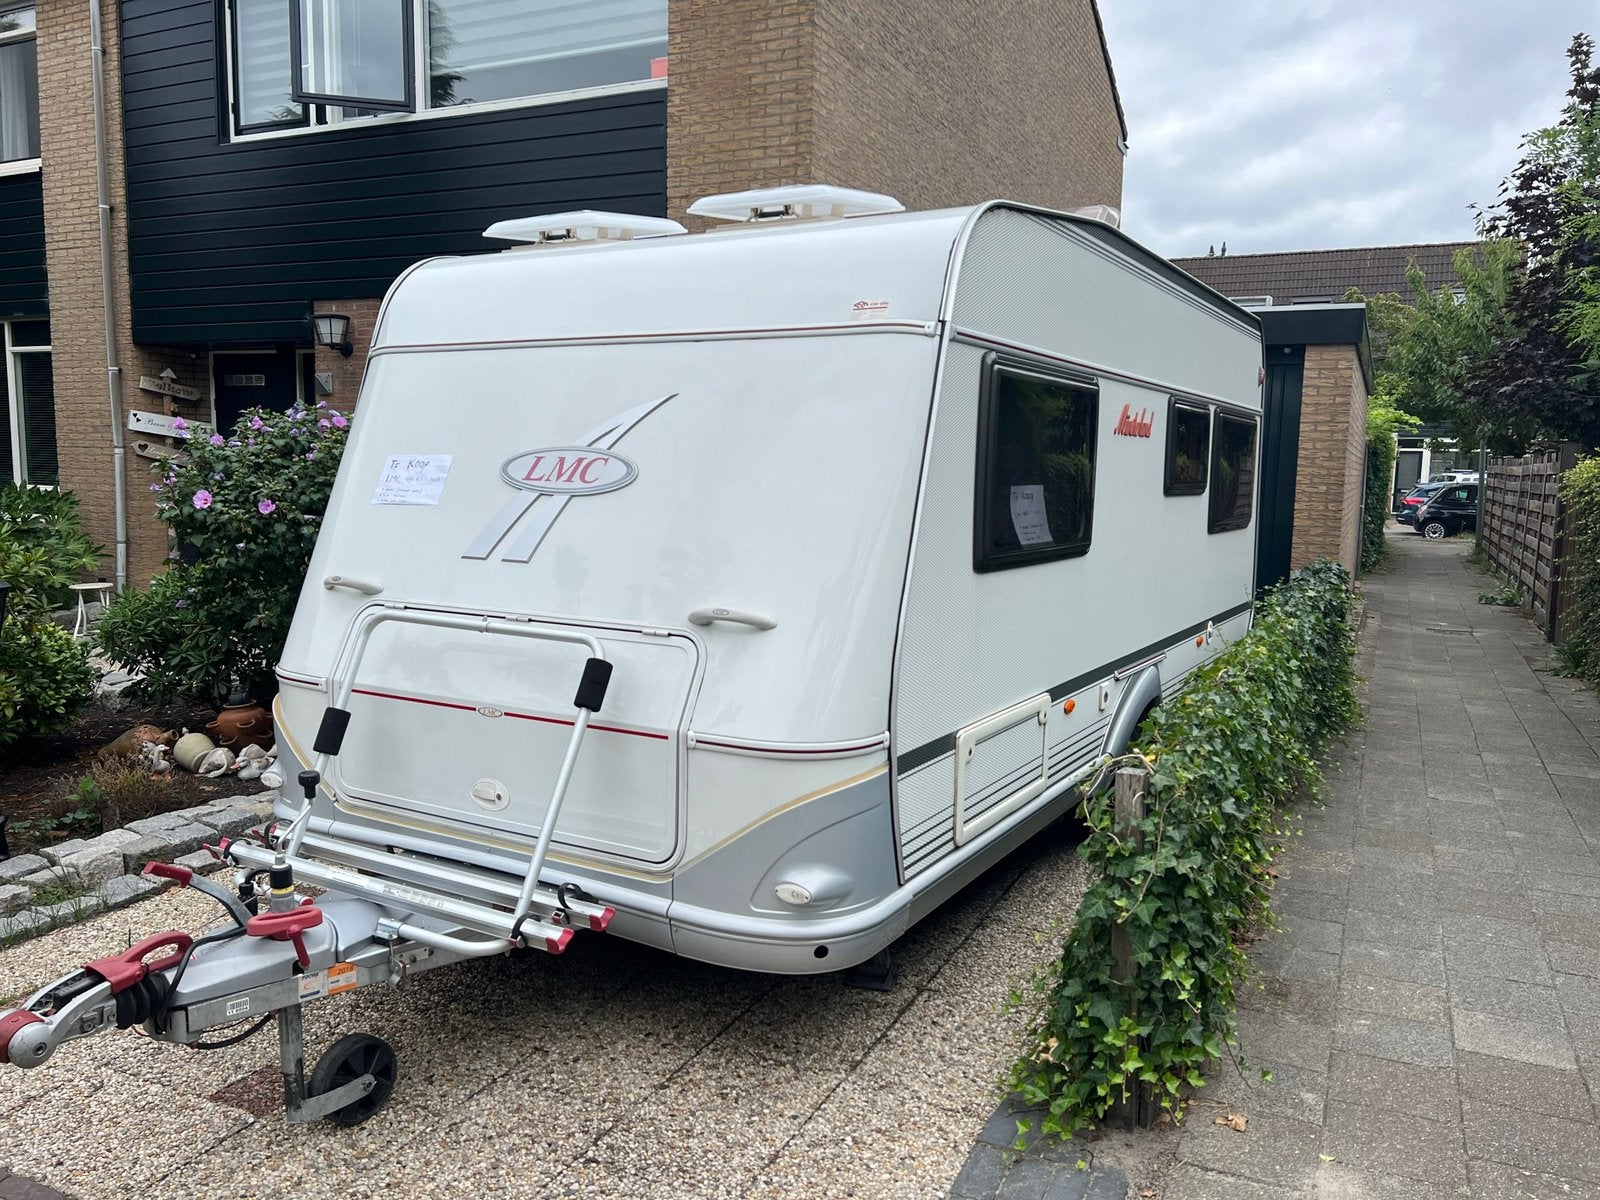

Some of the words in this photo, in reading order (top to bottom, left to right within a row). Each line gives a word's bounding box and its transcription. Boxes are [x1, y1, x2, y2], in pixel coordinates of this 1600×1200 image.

[406, 458, 430, 473] Koop
[521, 455, 610, 484] LMC
[336, 965, 355, 976] 2018
